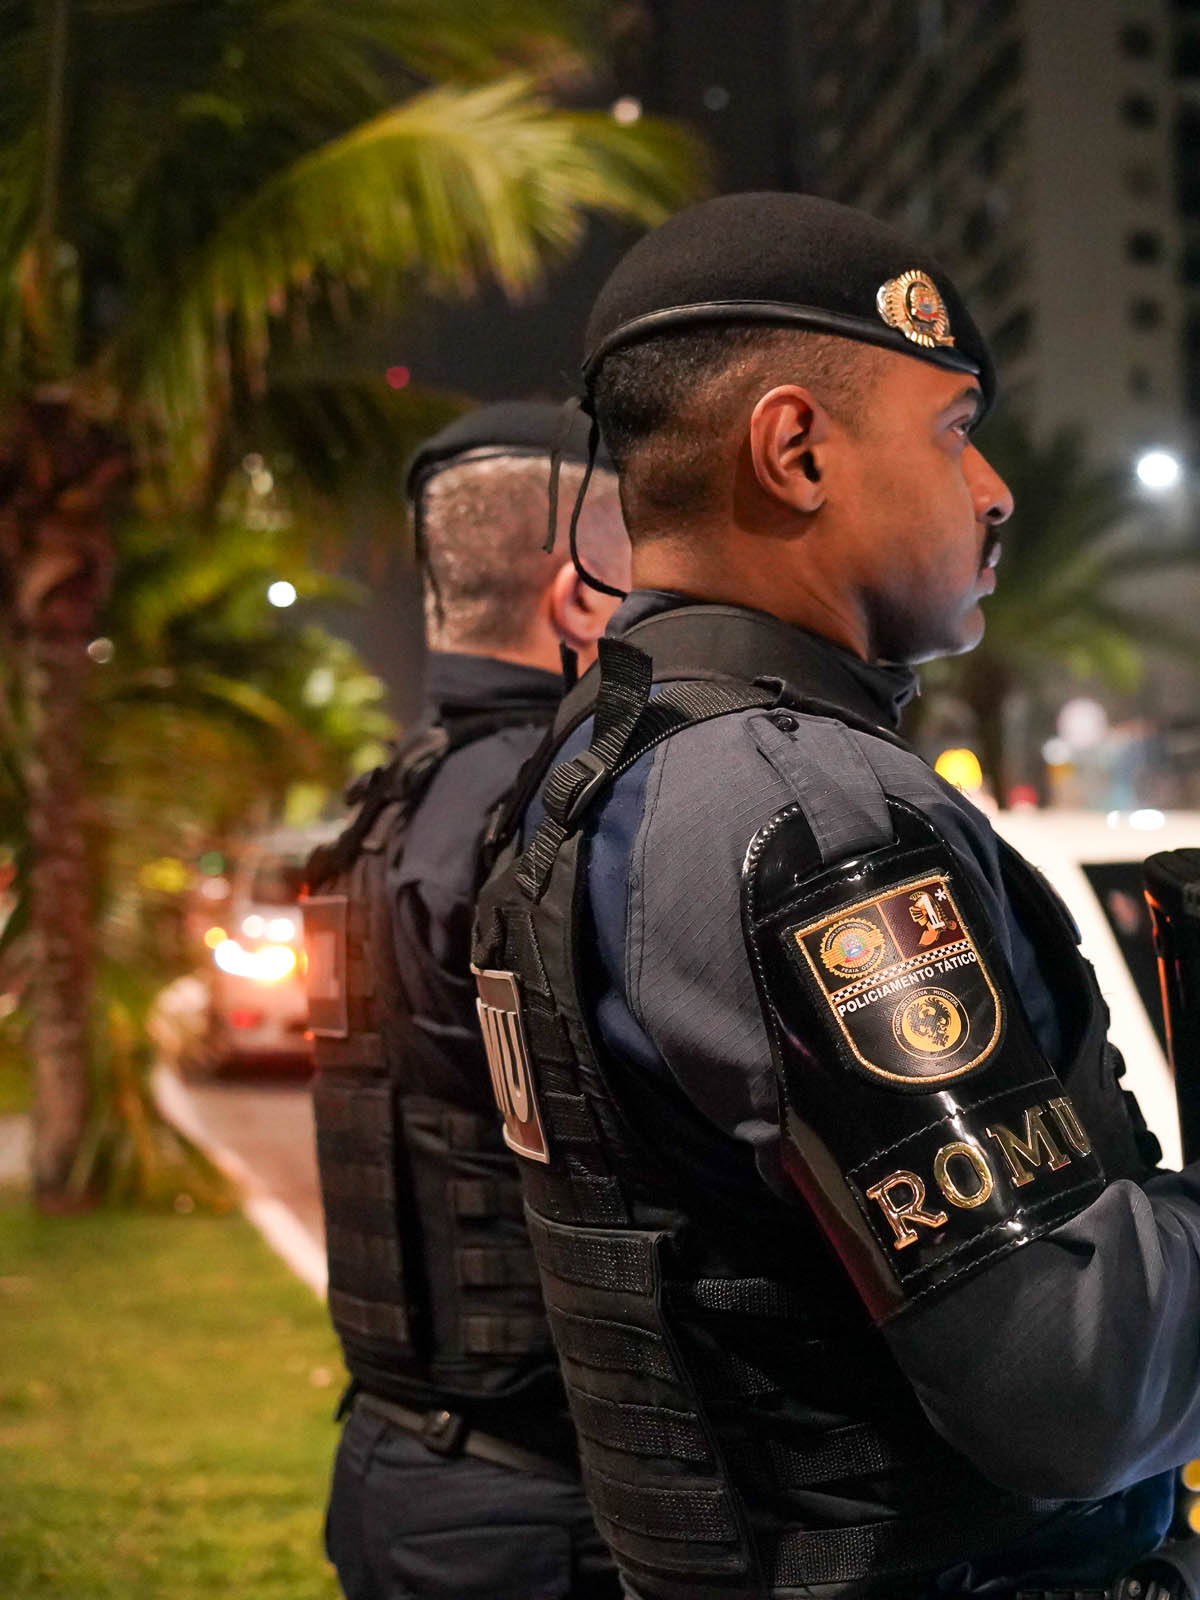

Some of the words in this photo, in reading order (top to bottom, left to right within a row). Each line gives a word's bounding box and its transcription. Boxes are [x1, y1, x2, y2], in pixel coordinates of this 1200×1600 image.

[837, 966, 935, 1017] POLICIAMENTO
[935, 951, 977, 974] TÁTICO
[866, 1097, 1092, 1251] ROMU
